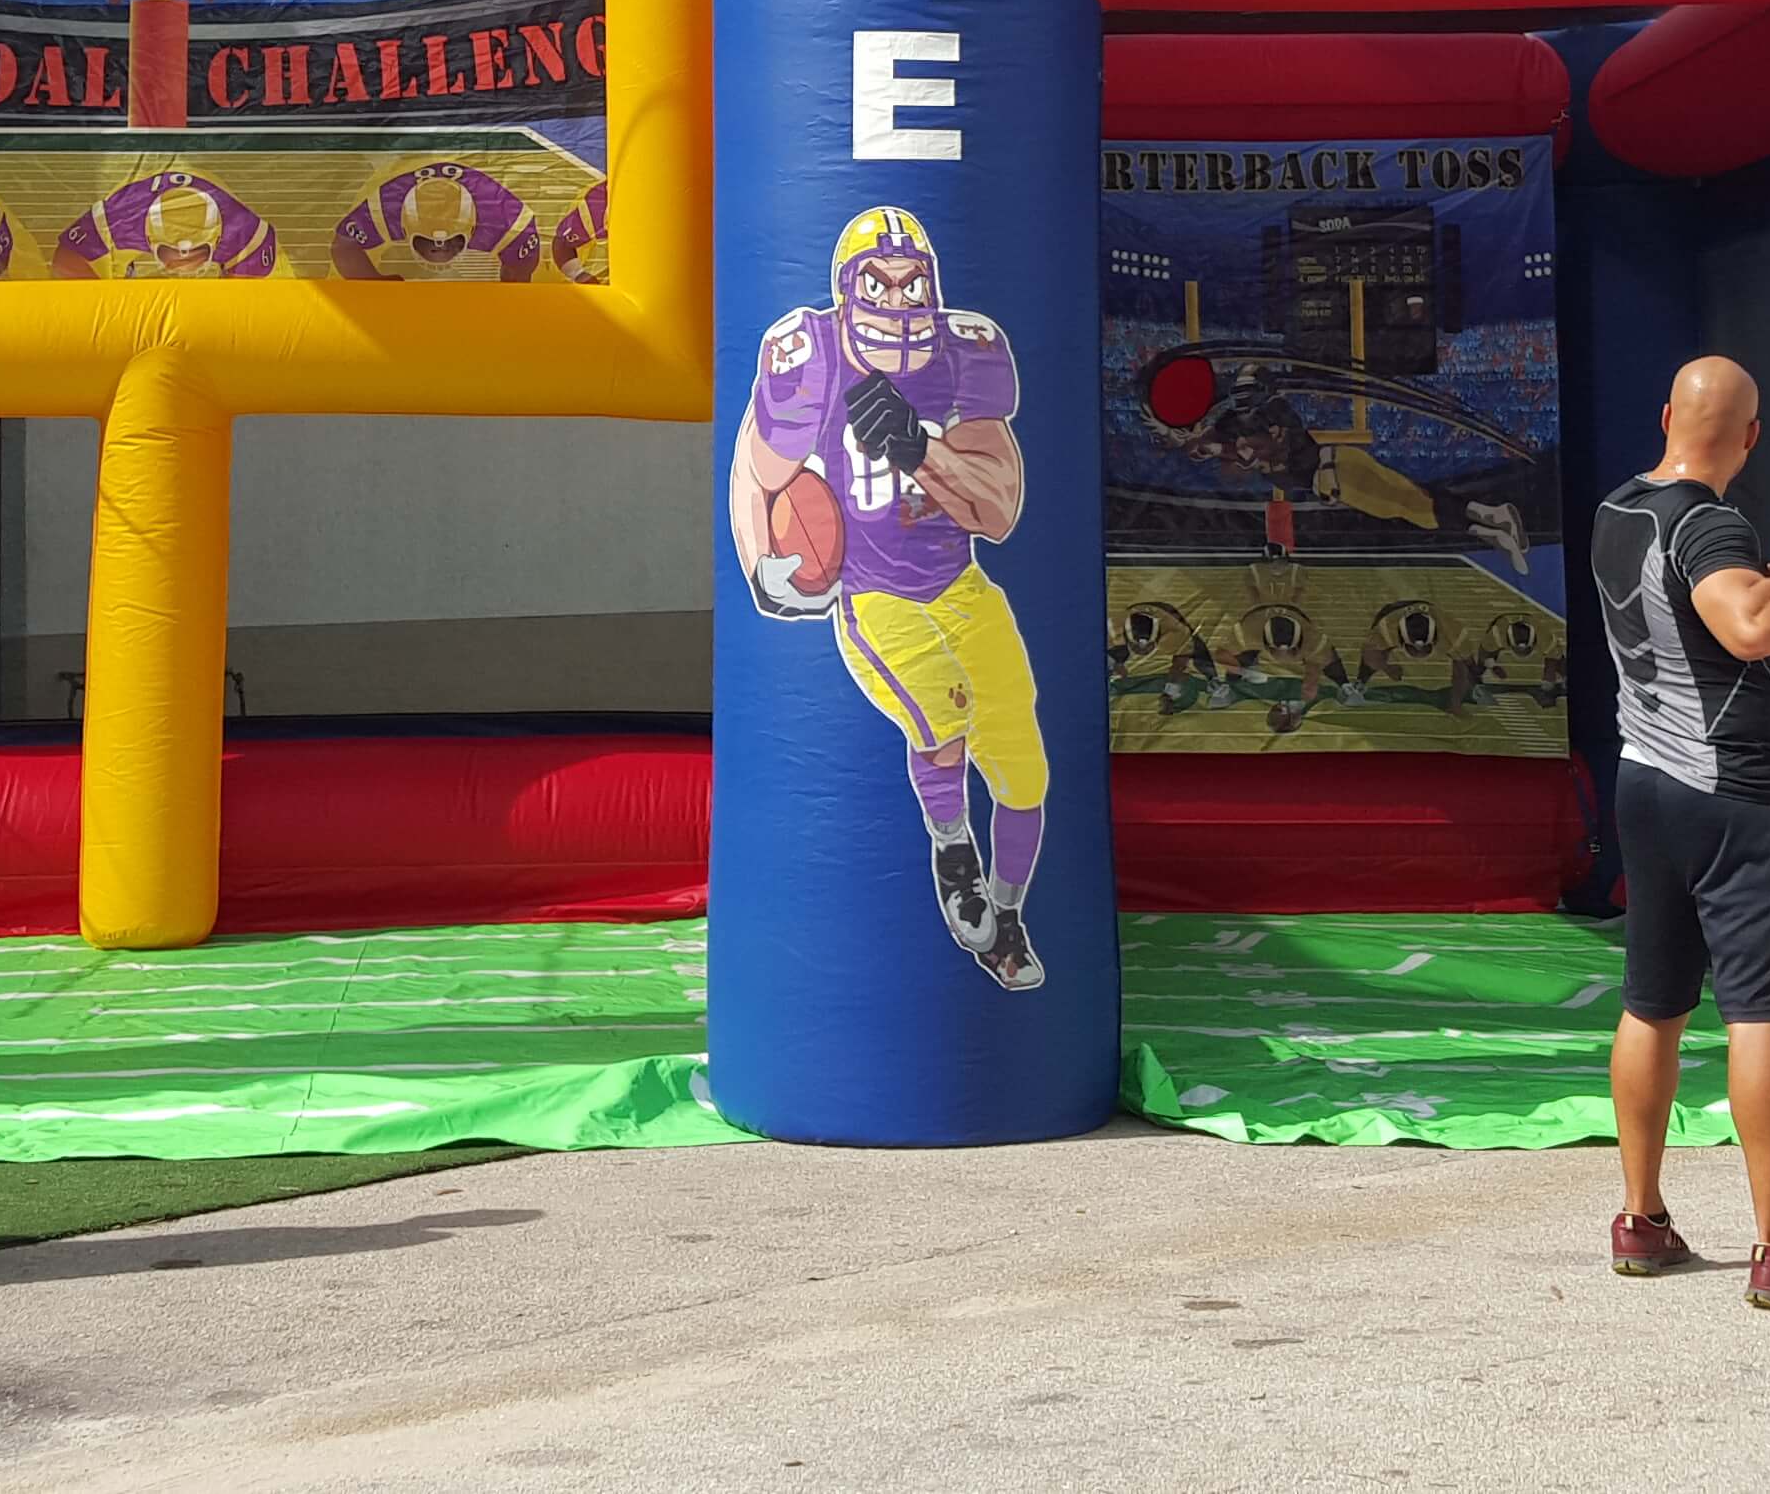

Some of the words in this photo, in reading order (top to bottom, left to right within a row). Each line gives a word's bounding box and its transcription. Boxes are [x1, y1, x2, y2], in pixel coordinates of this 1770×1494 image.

[206, 14, 606, 109] CHALLENG
[1101, 148, 1380, 196] RTERBACK
[1397, 146, 1526, 192] TOSS
